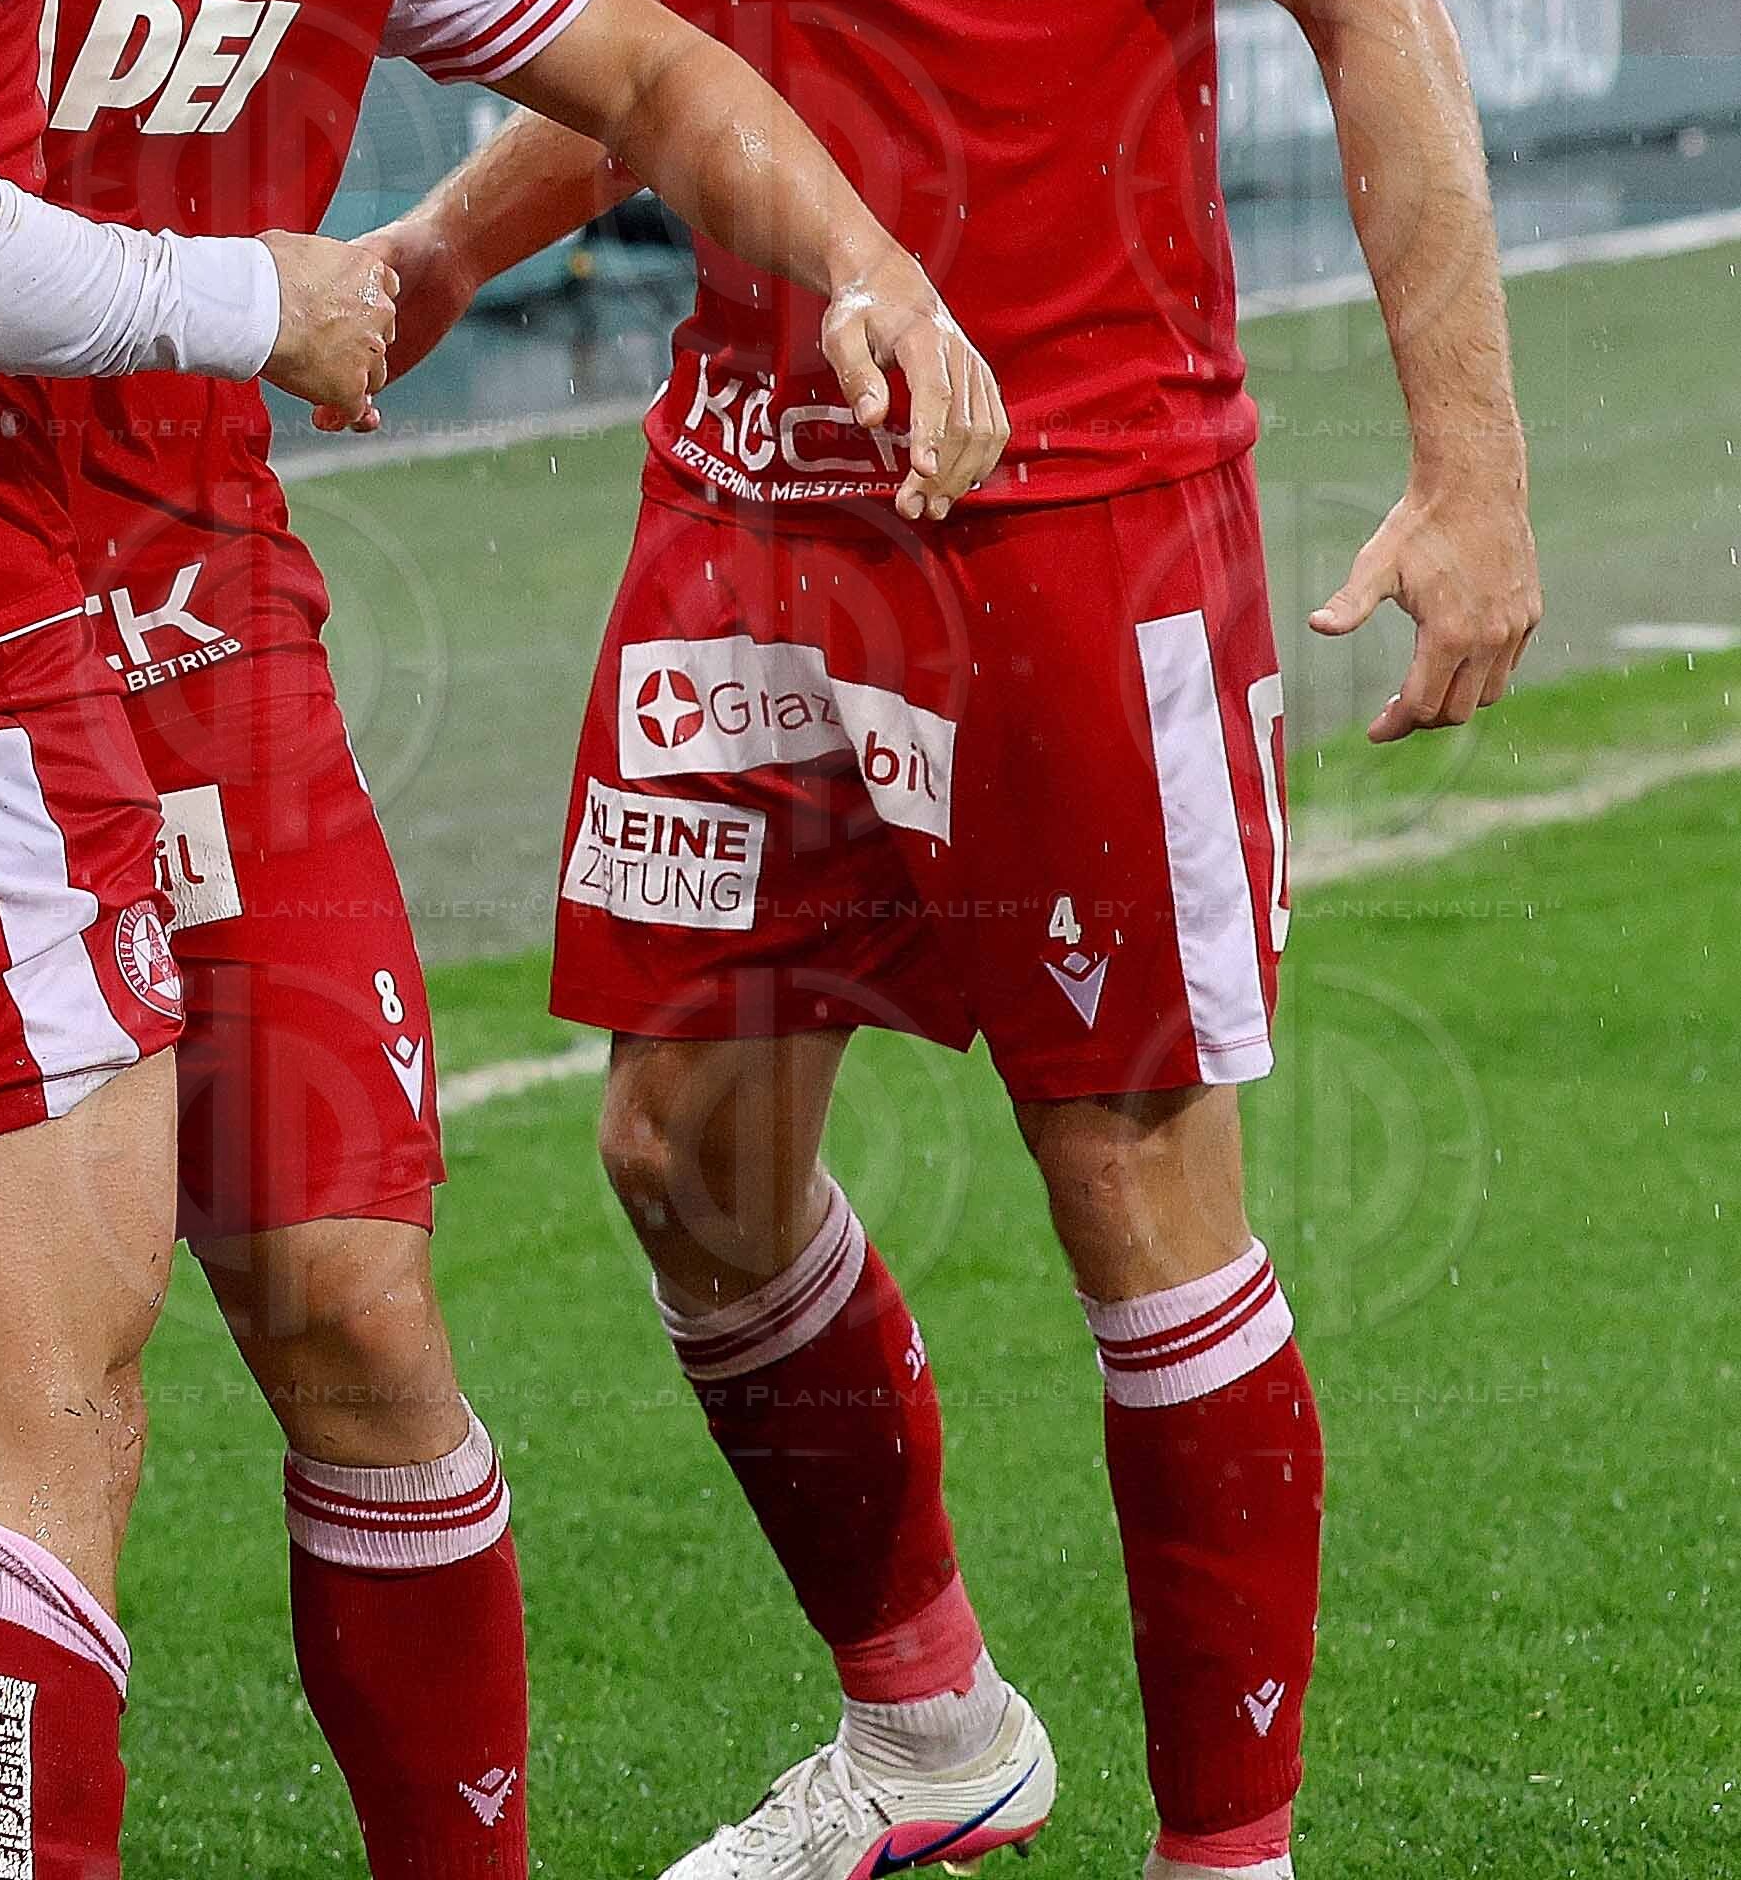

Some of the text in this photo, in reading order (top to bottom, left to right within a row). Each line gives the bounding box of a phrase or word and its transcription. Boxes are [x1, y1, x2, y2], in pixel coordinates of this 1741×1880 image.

[864, 730, 937, 802] bil
[589, 794, 751, 864] KLEINE
[1048, 896, 1081, 945] 4
[373, 969, 404, 1025] 8
